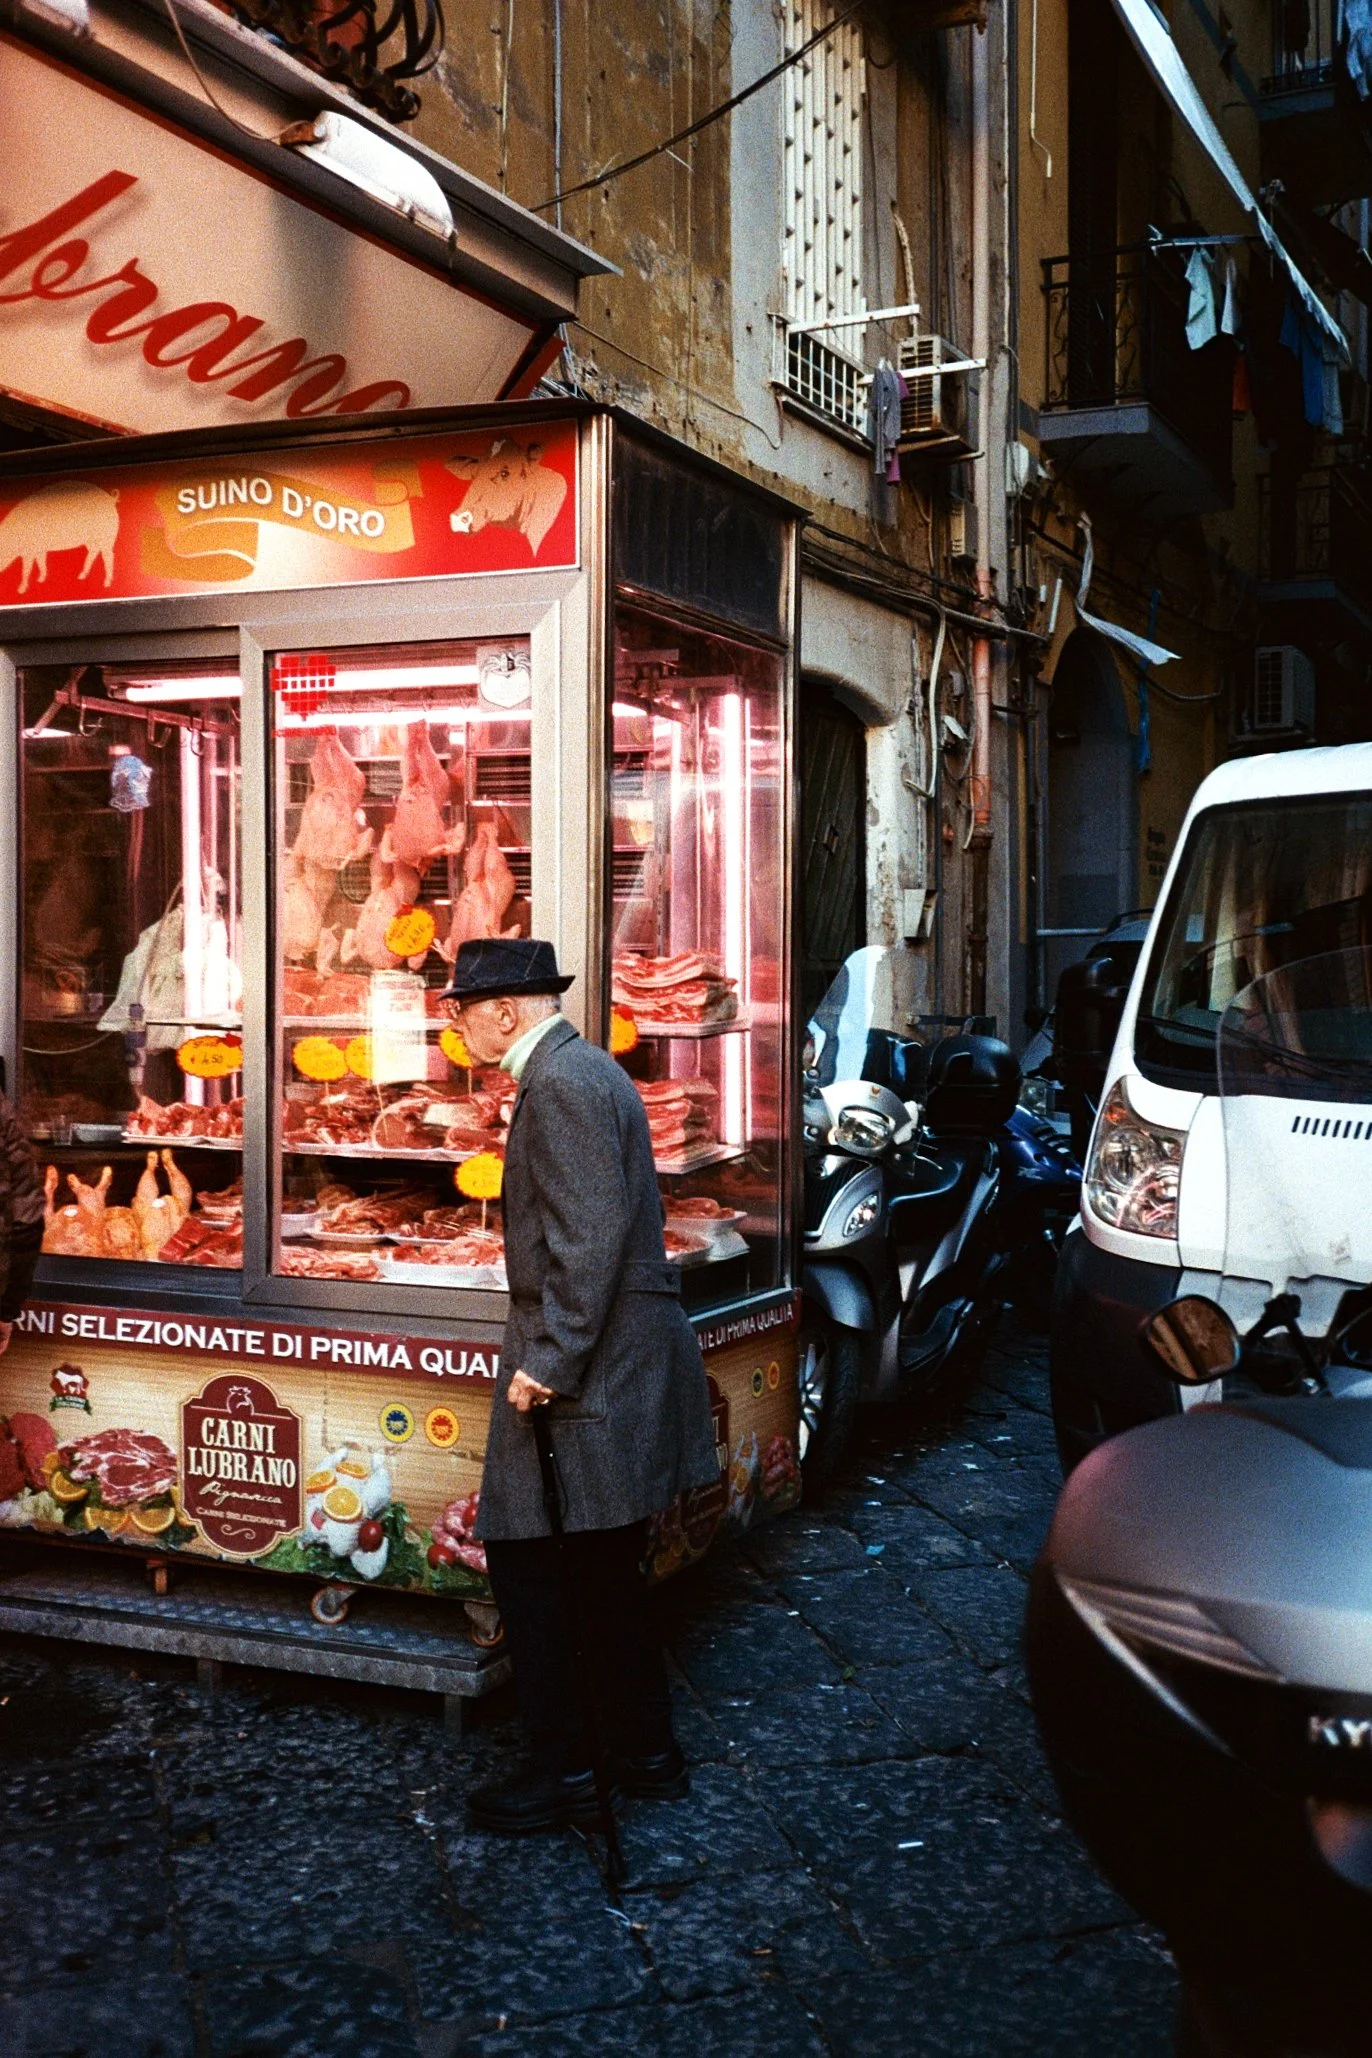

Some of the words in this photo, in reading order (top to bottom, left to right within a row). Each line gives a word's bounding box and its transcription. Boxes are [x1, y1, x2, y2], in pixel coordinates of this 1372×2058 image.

[176, 477, 273, 514] SUINO
[61, 1313, 265, 1355] SELEZIONATE
[272, 1332, 302, 1359] DI
[310, 1336, 413, 1371] PRIMA
[201, 1417, 276, 1454] CARNI
[187, 1446, 297, 1488] LUBRANO
[1310, 1716, 1372, 1747] KY
